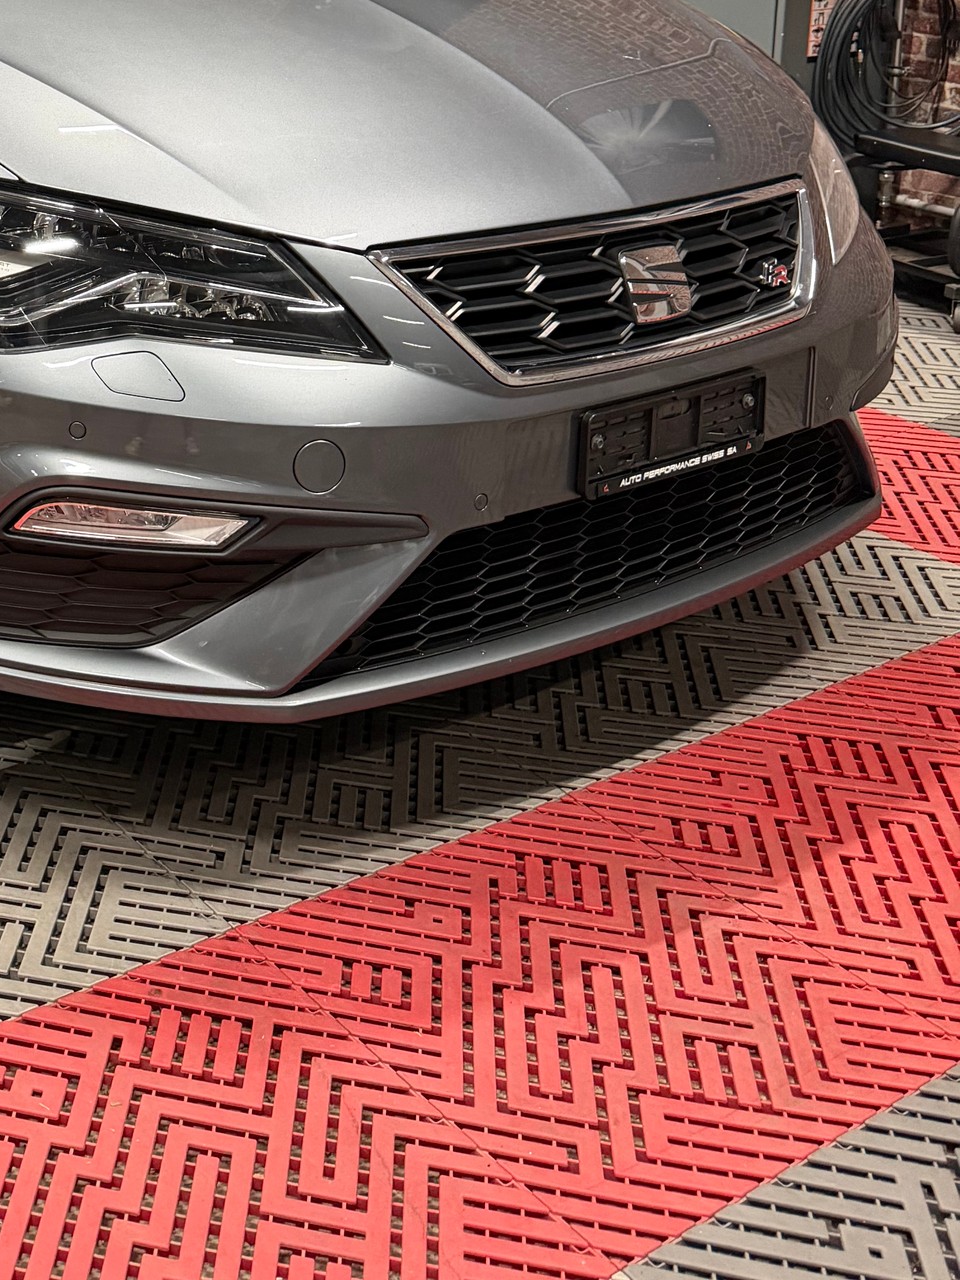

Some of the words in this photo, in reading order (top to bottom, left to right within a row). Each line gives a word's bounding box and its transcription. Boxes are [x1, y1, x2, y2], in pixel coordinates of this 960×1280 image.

[619, 473, 642, 488] AUTO
[642, 456, 701, 480] PERFORMANCE
[701, 449, 725, 464] SWISS
[726, 445, 737, 456] SA
